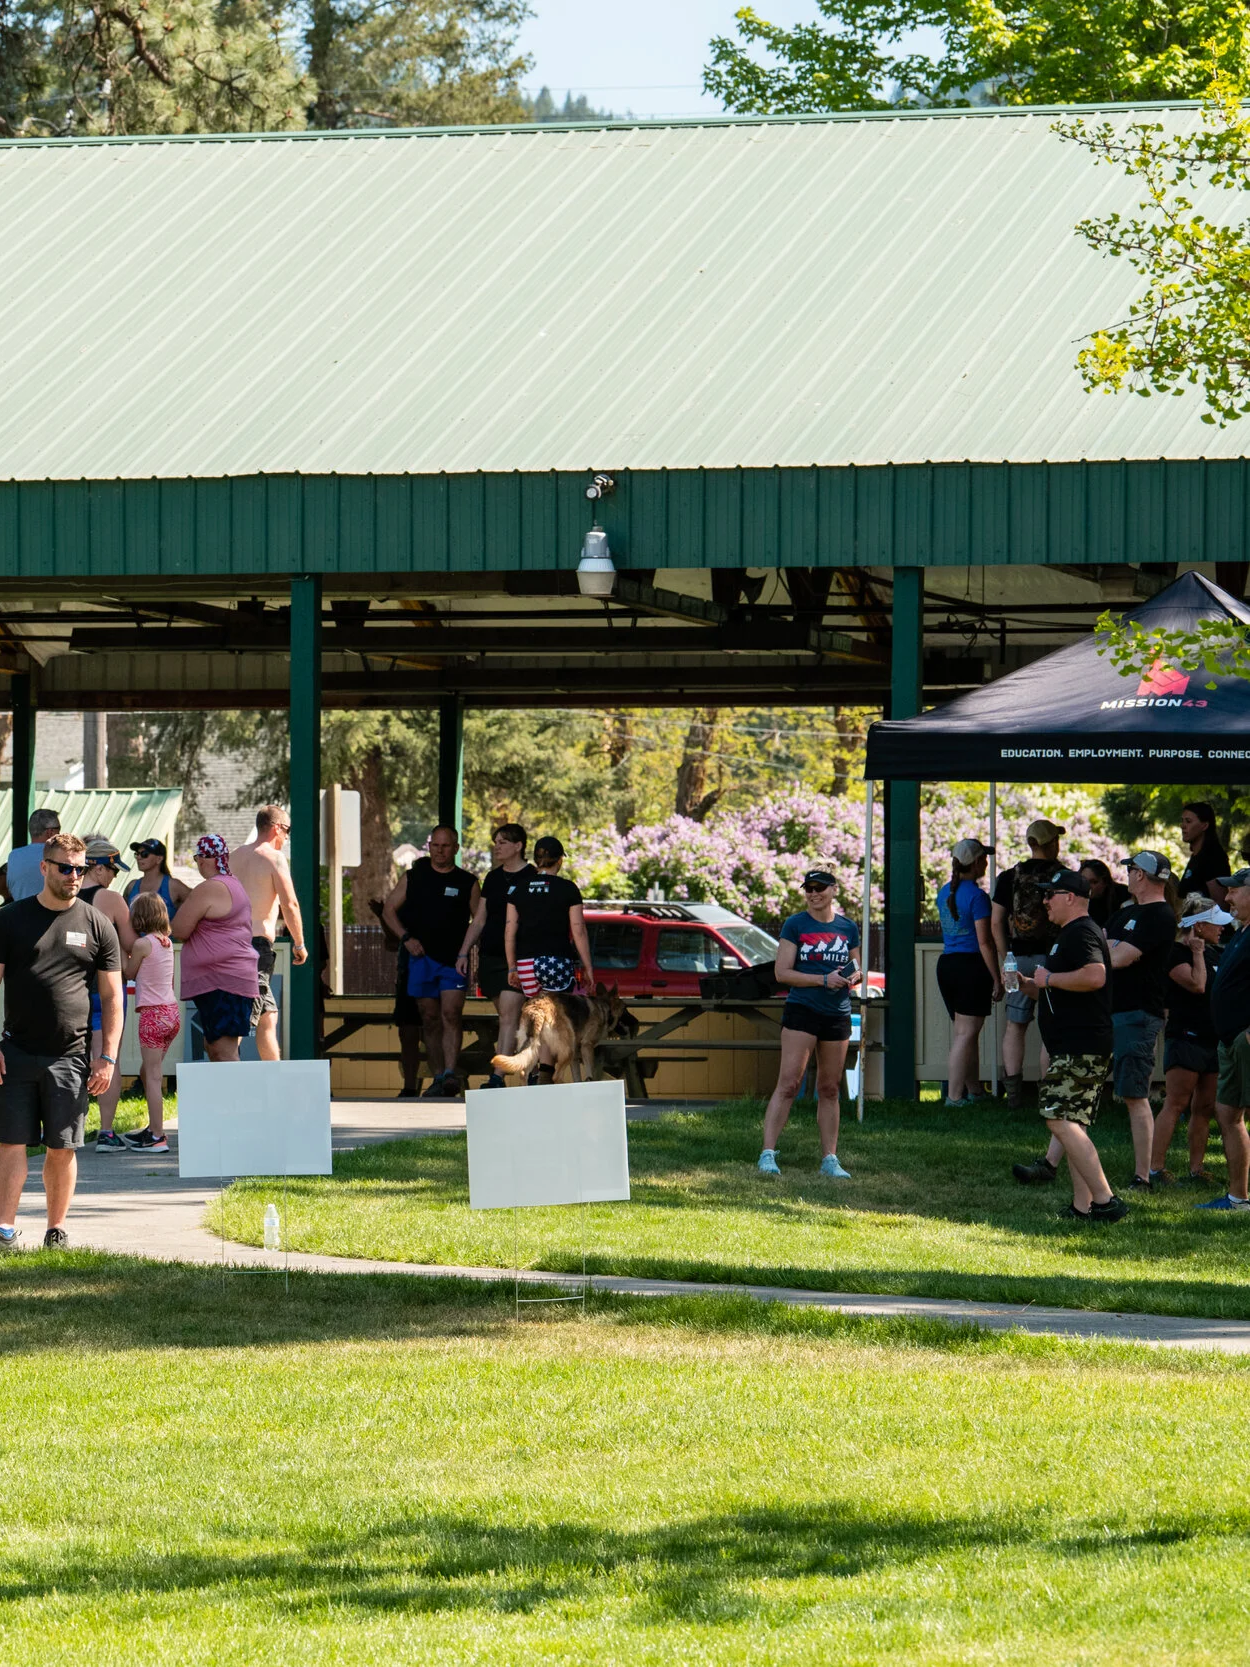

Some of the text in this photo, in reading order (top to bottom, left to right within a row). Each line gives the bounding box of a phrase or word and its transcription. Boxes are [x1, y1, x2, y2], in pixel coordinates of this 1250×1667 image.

[1100, 698, 1208, 710] MISSION43
[1000, 748, 1064, 758] EDUCATION.
[1068, 748, 1144, 758] EMPLOYMENT.
[1148, 749, 1203, 759] PURPOSE.
